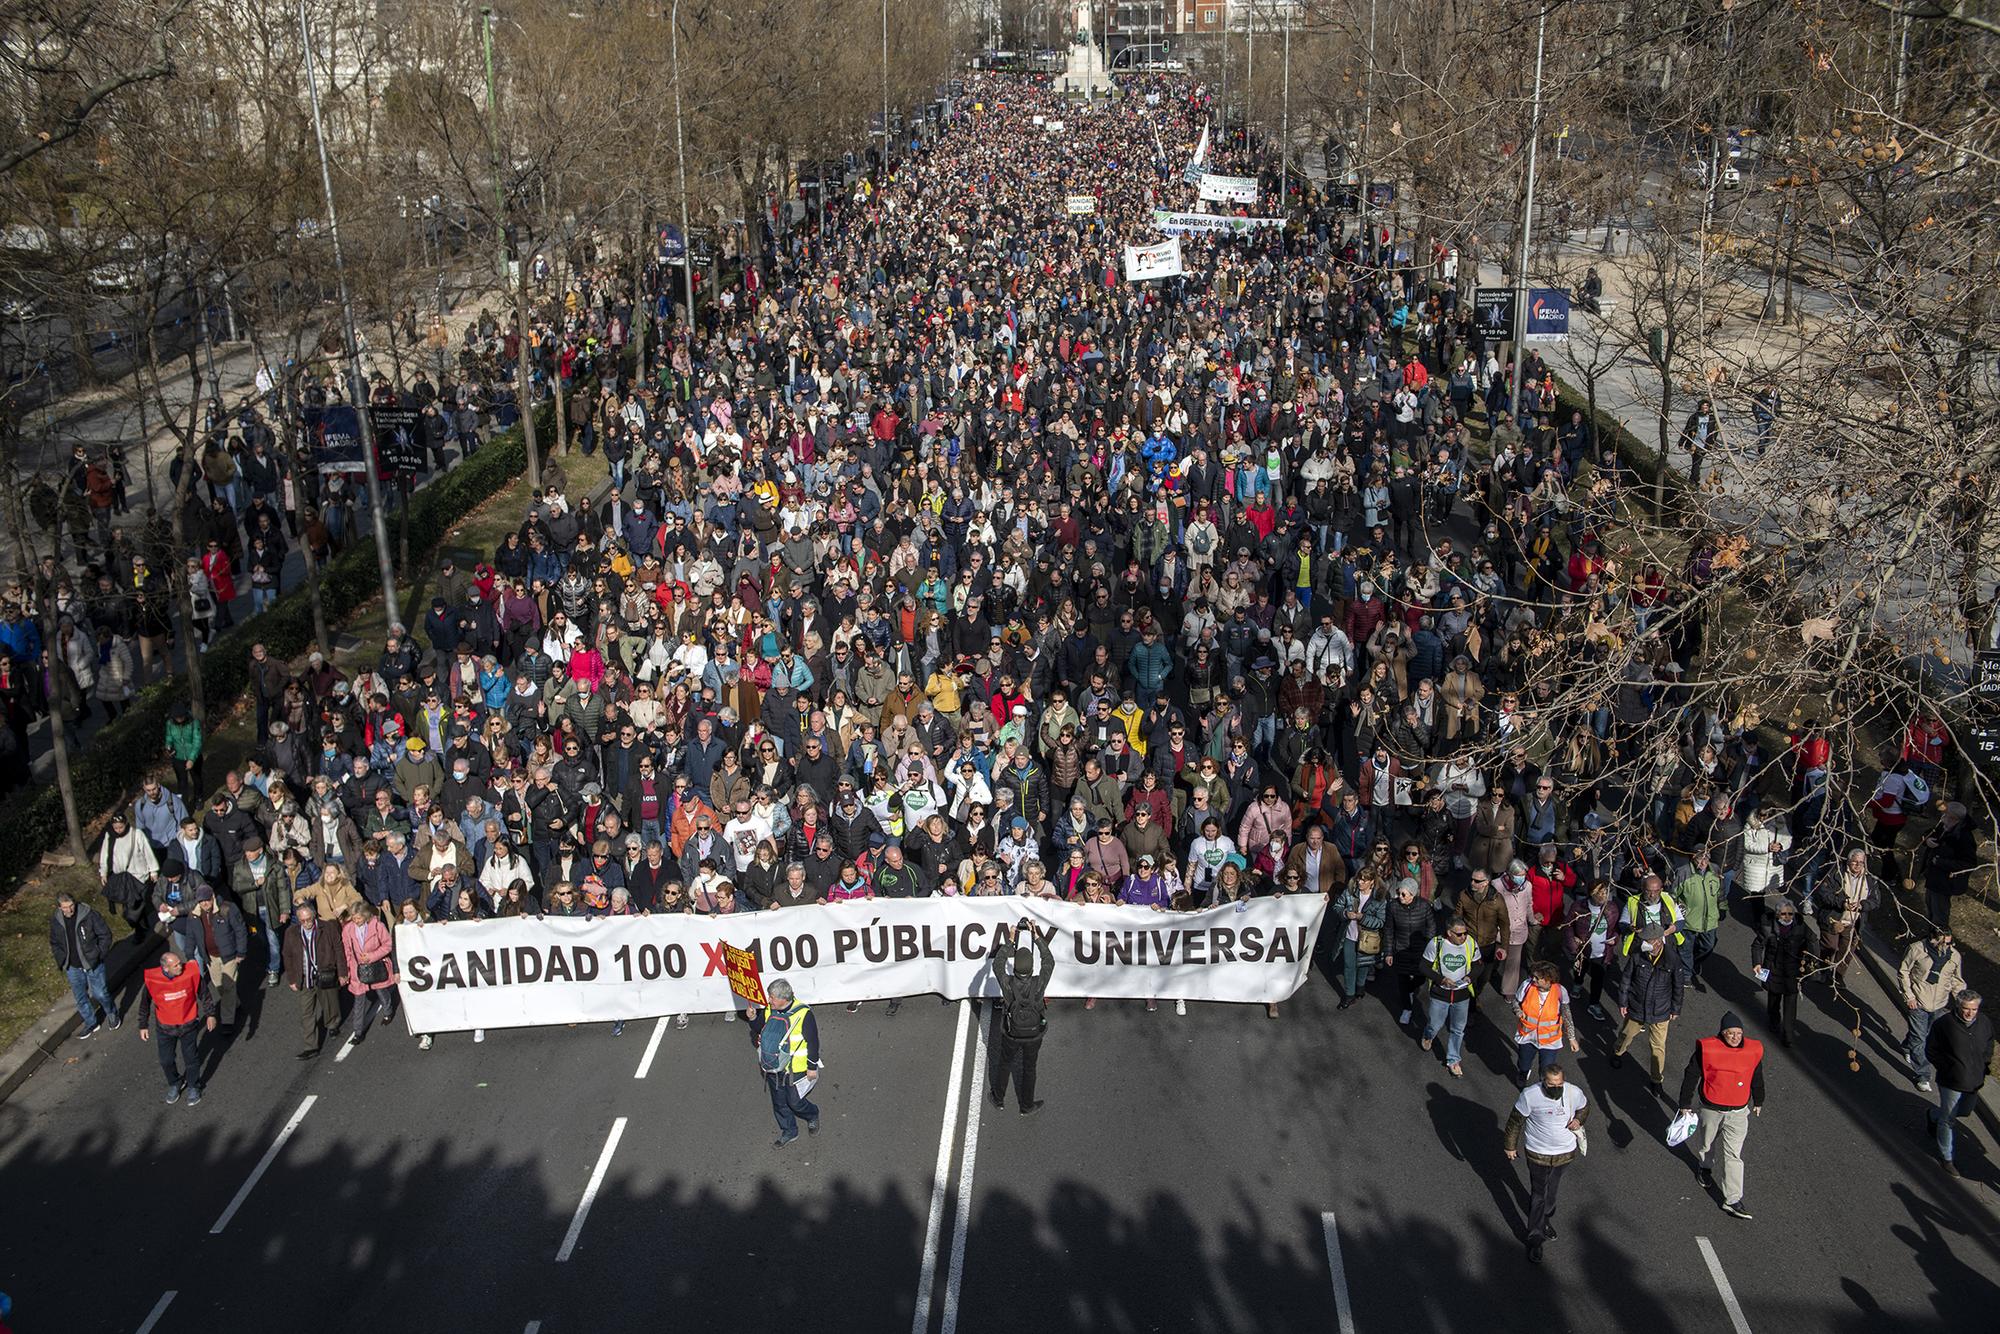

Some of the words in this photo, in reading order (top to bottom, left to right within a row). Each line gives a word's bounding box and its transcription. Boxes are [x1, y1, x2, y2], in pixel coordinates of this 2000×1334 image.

[1179, 219, 1212, 228] DEFENSA
[1214, 220, 1223, 228] de
[1224, 221, 1232, 229] la
[325, 433, 351, 441] IFEMA
[326, 440, 358, 448] MADRID
[410, 456, 422, 464] feb
[408, 945, 599, 993] SANIDAD
[614, 943, 687, 982] 100
[703, 942, 728, 977] X
[745, 935, 818, 972] 100
[833, 917, 1013, 964] PÚBLICA
